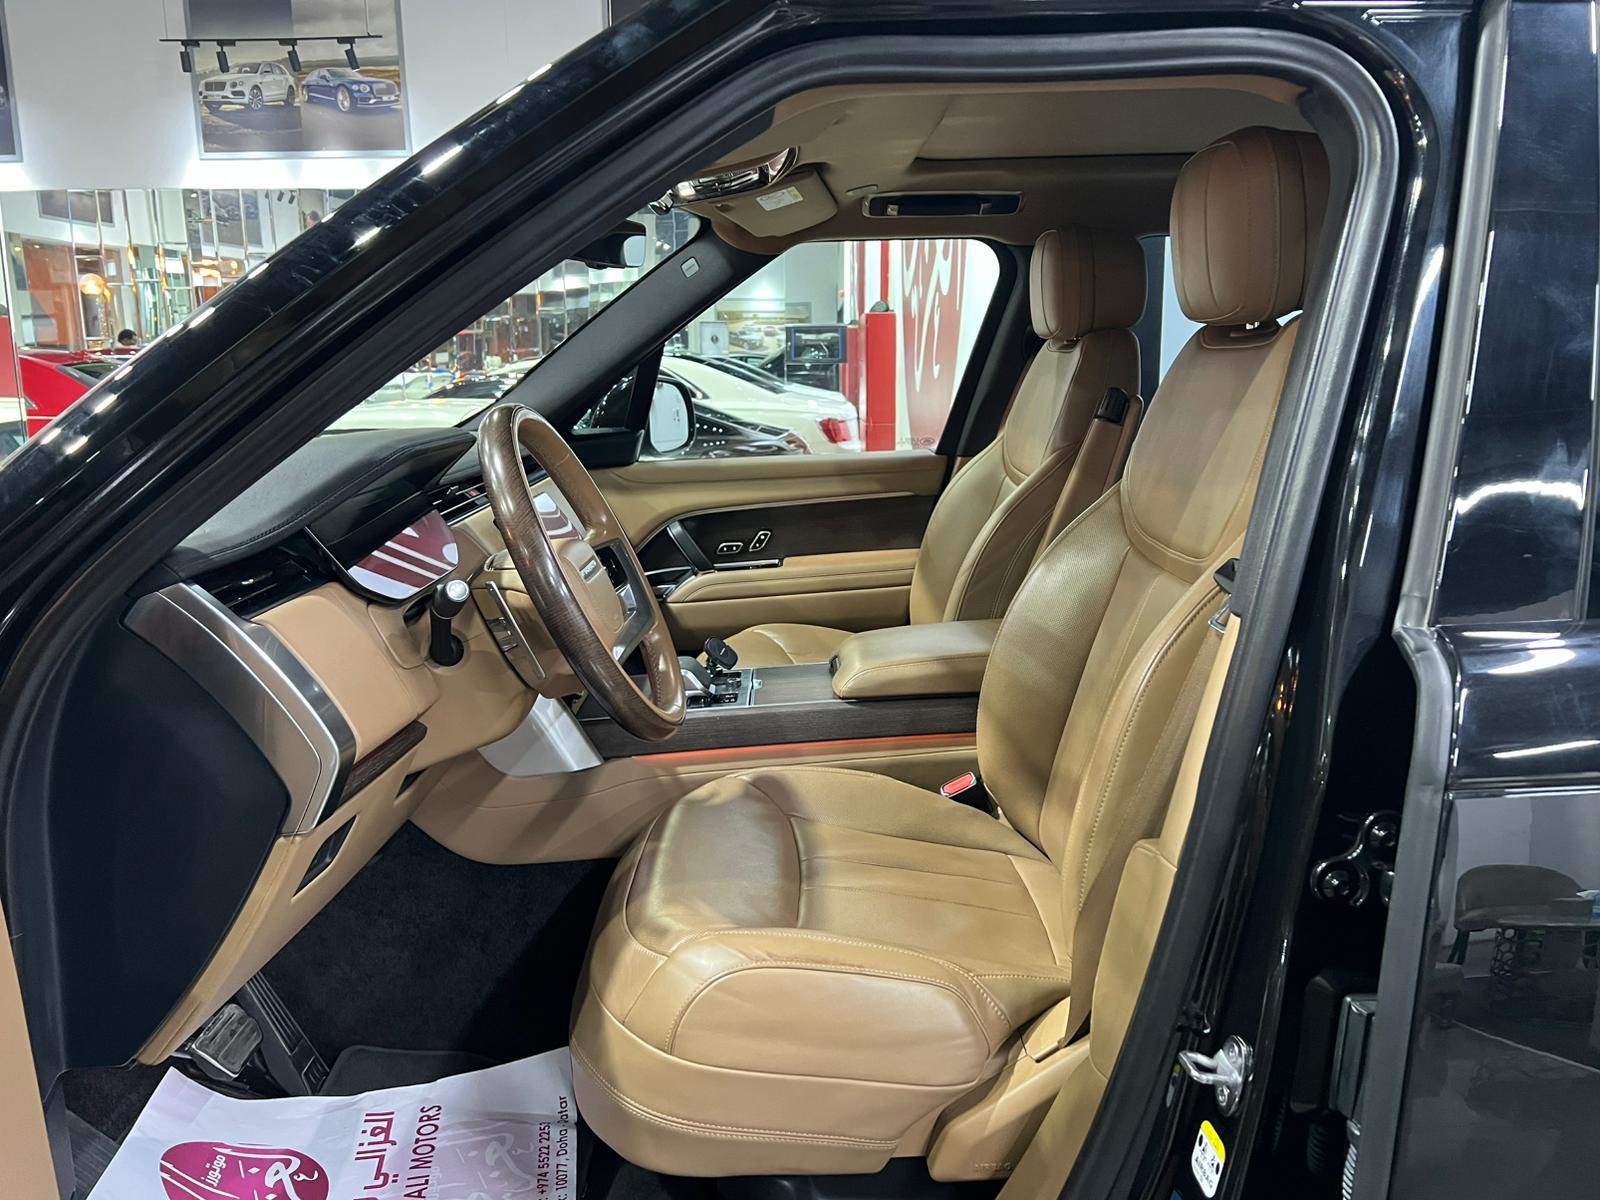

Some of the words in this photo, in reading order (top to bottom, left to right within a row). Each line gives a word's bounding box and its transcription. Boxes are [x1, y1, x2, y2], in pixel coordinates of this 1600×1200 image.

[354, 1111, 400, 1191] الغزالي
[409, 1105, 442, 1170] MOTORS
[556, 1129, 568, 1157] Doha
[538, 1144, 550, 1169] 5522
[536, 1171, 550, 1195] +974
[556, 1163, 568, 1191] 10077
